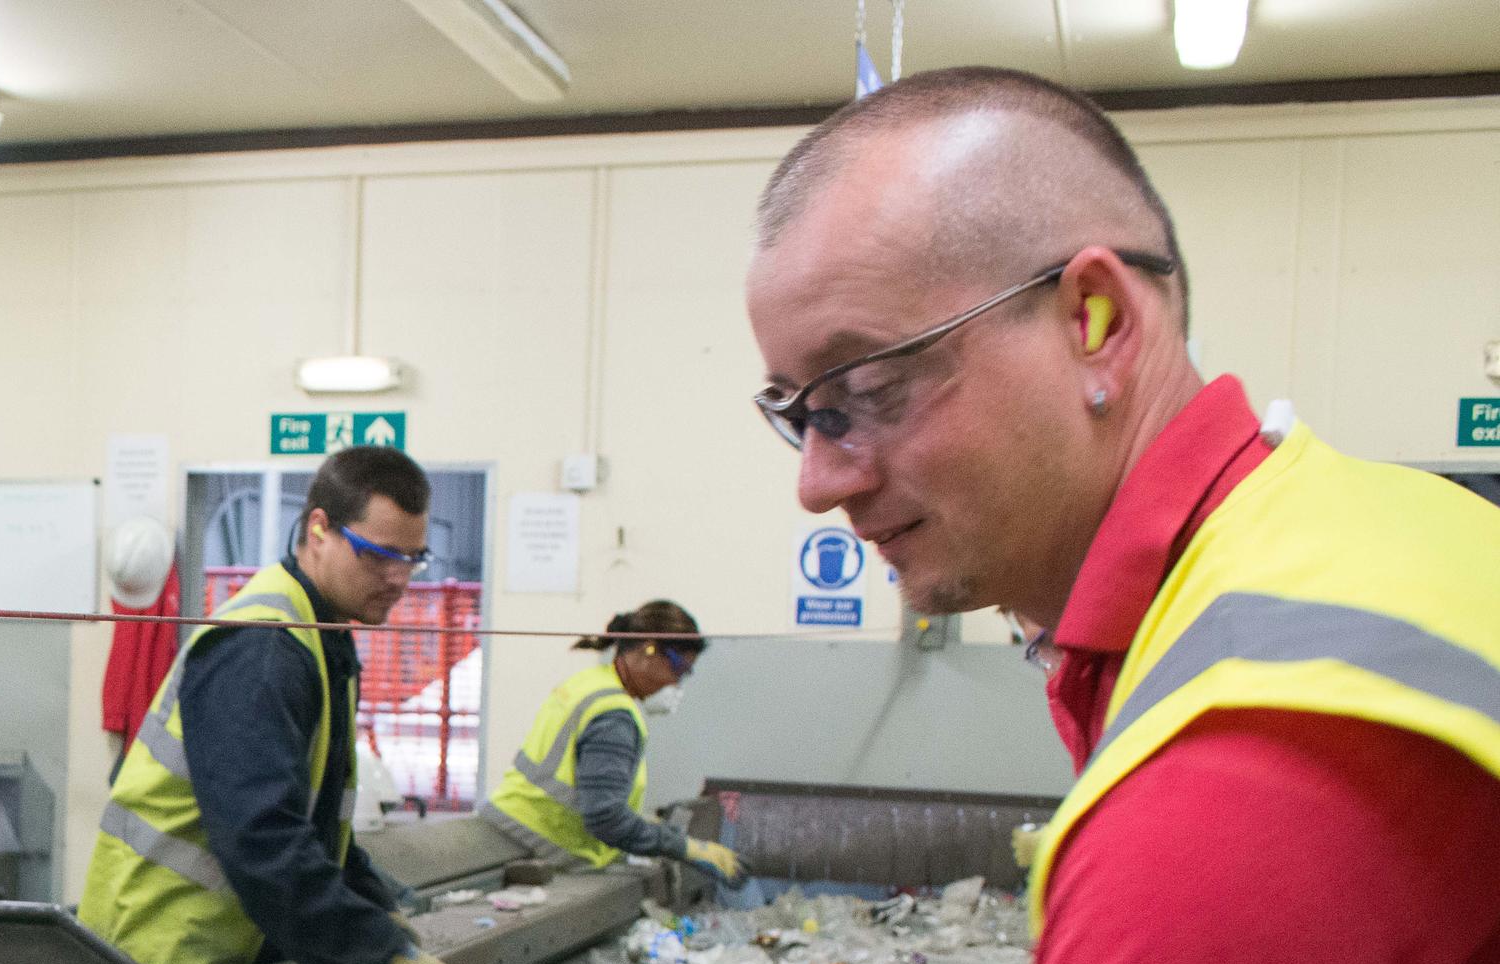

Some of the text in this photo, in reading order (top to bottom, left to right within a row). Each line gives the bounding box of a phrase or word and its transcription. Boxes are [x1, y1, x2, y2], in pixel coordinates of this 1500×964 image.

[1471, 403, 1500, 421] Fir
[279, 417, 311, 434] Fire
[1471, 424, 1500, 441] exi
[279, 435, 309, 451] exit
